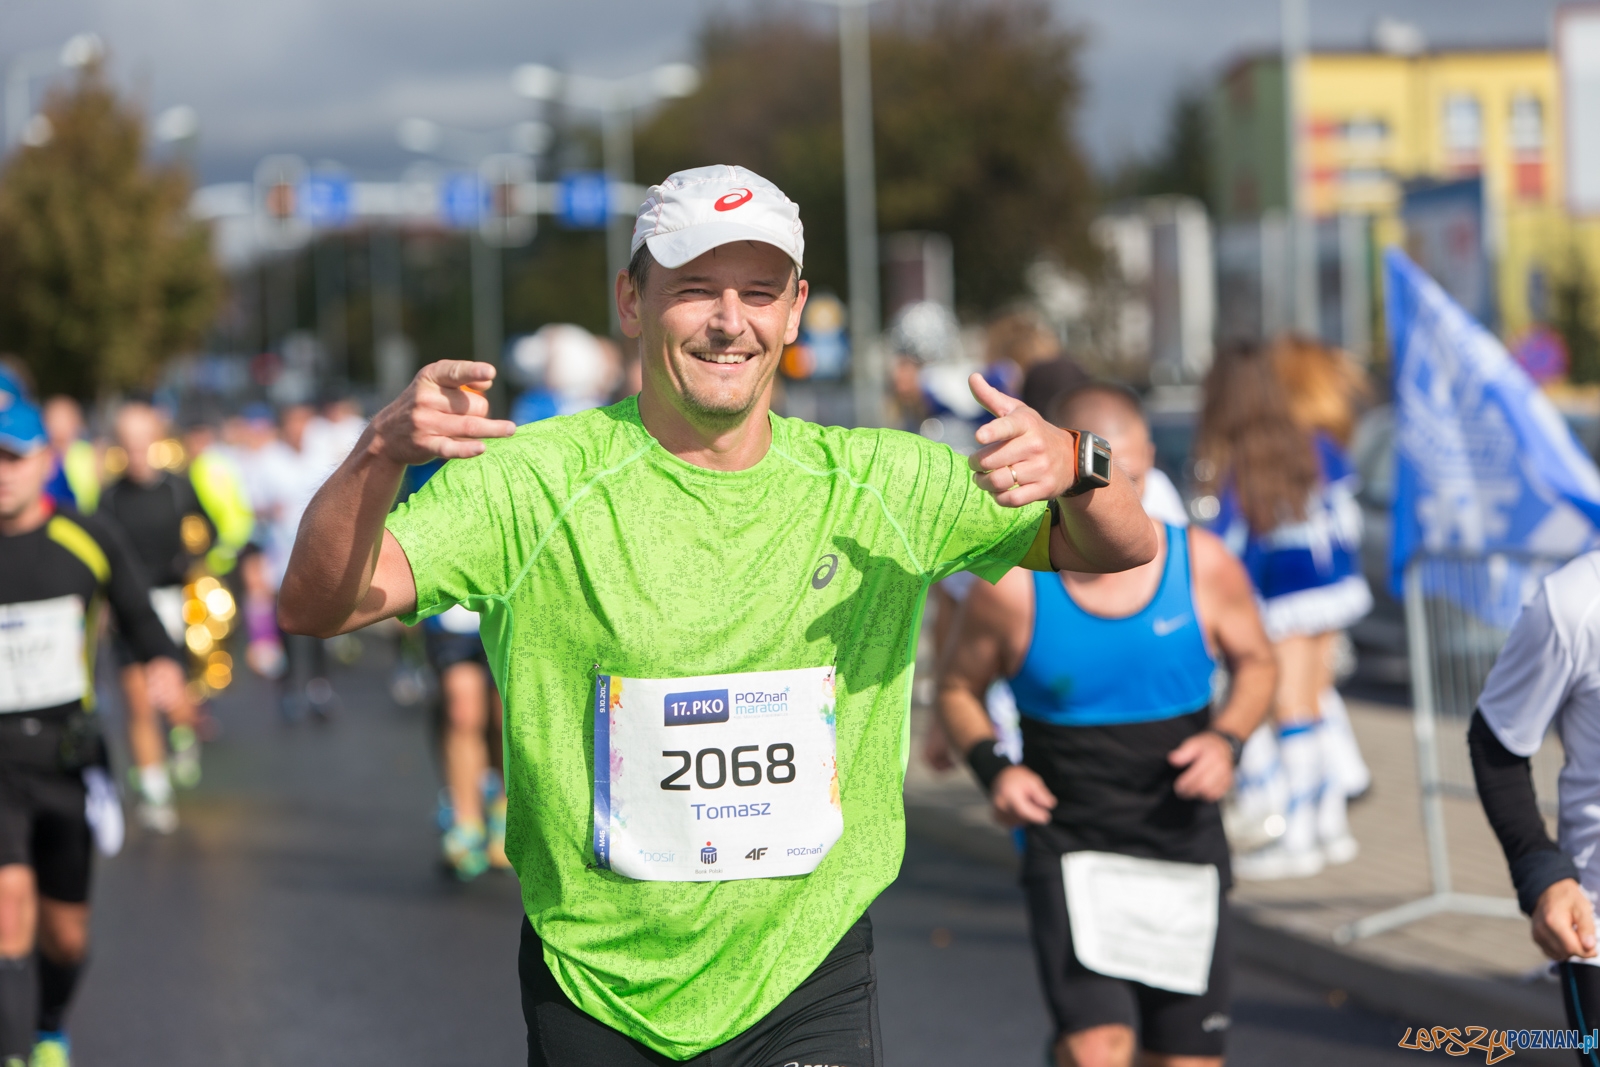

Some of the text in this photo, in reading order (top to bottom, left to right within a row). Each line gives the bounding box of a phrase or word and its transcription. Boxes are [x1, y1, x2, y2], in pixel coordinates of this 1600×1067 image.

[598, 680, 607, 713] 9.10.201
[735, 701, 788, 715] maraton
[660, 742, 796, 791] 2068
[690, 802, 771, 820] Tomasz
